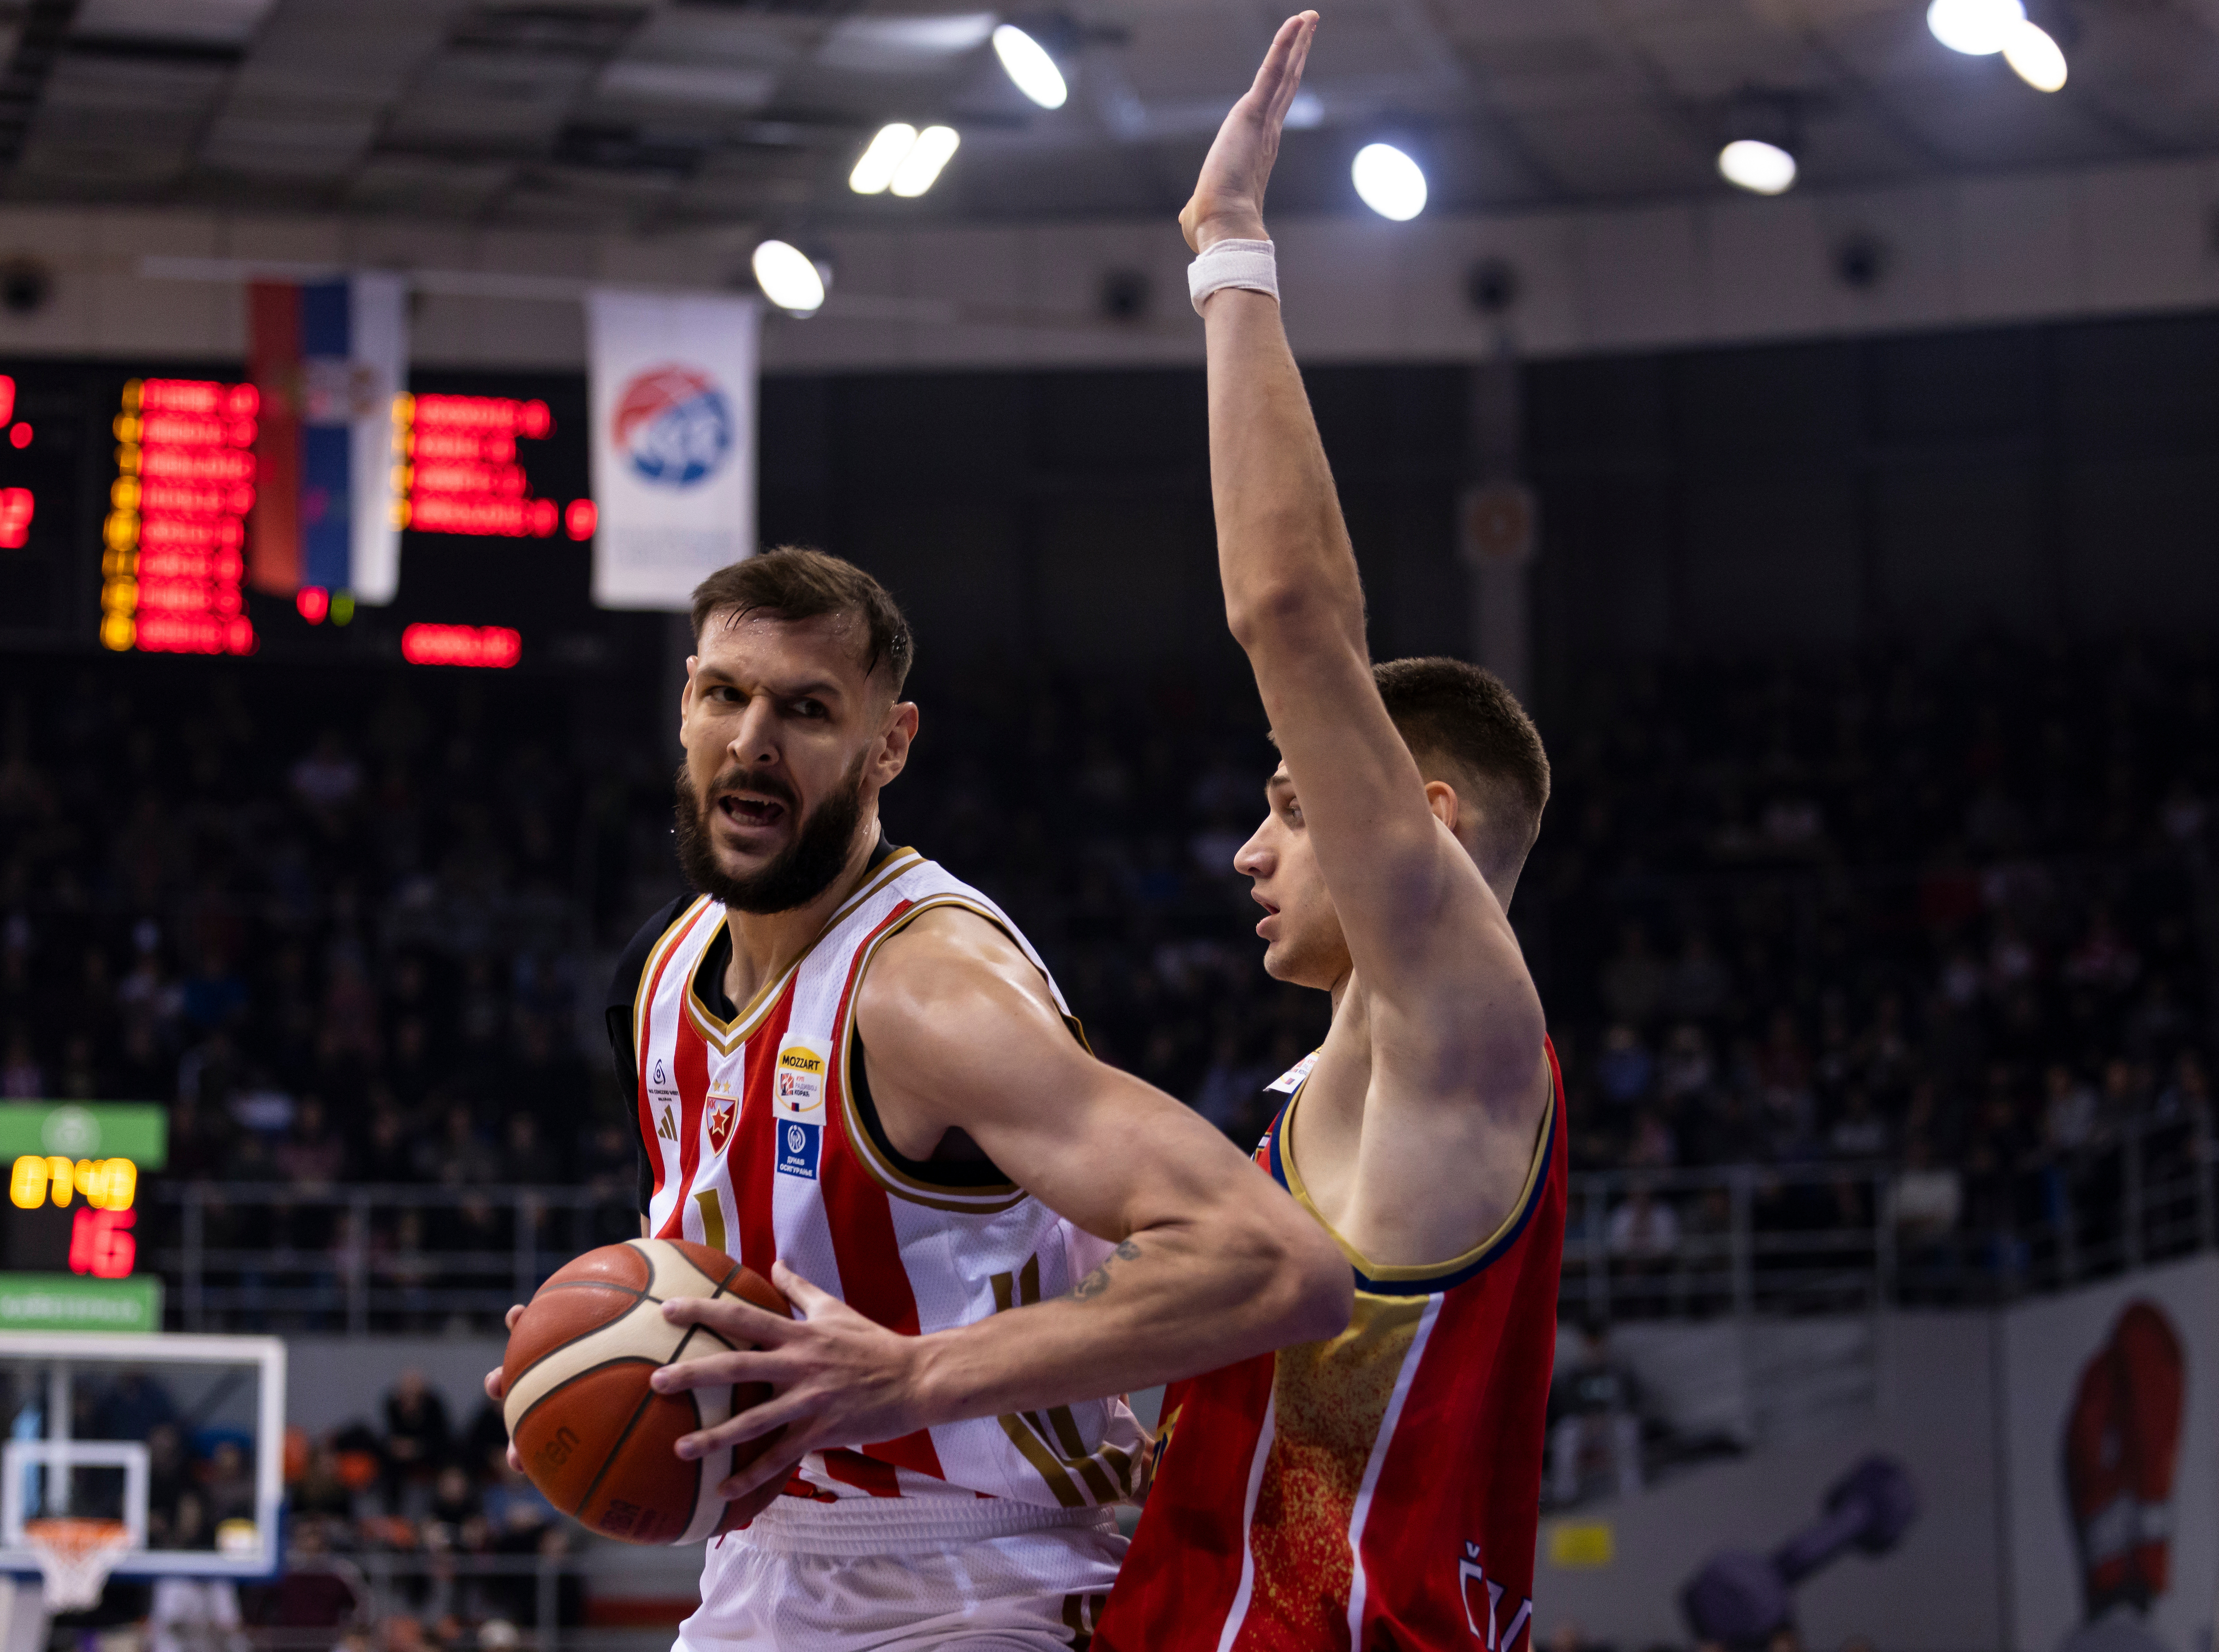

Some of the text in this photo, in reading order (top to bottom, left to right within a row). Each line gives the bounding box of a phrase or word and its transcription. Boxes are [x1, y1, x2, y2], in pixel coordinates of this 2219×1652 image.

[782, 1054, 821, 1071] MOZZART
[787, 1156, 805, 1166] ДУНАВ
[779, 1163, 813, 1177] ОСИГУРАЊЕ
